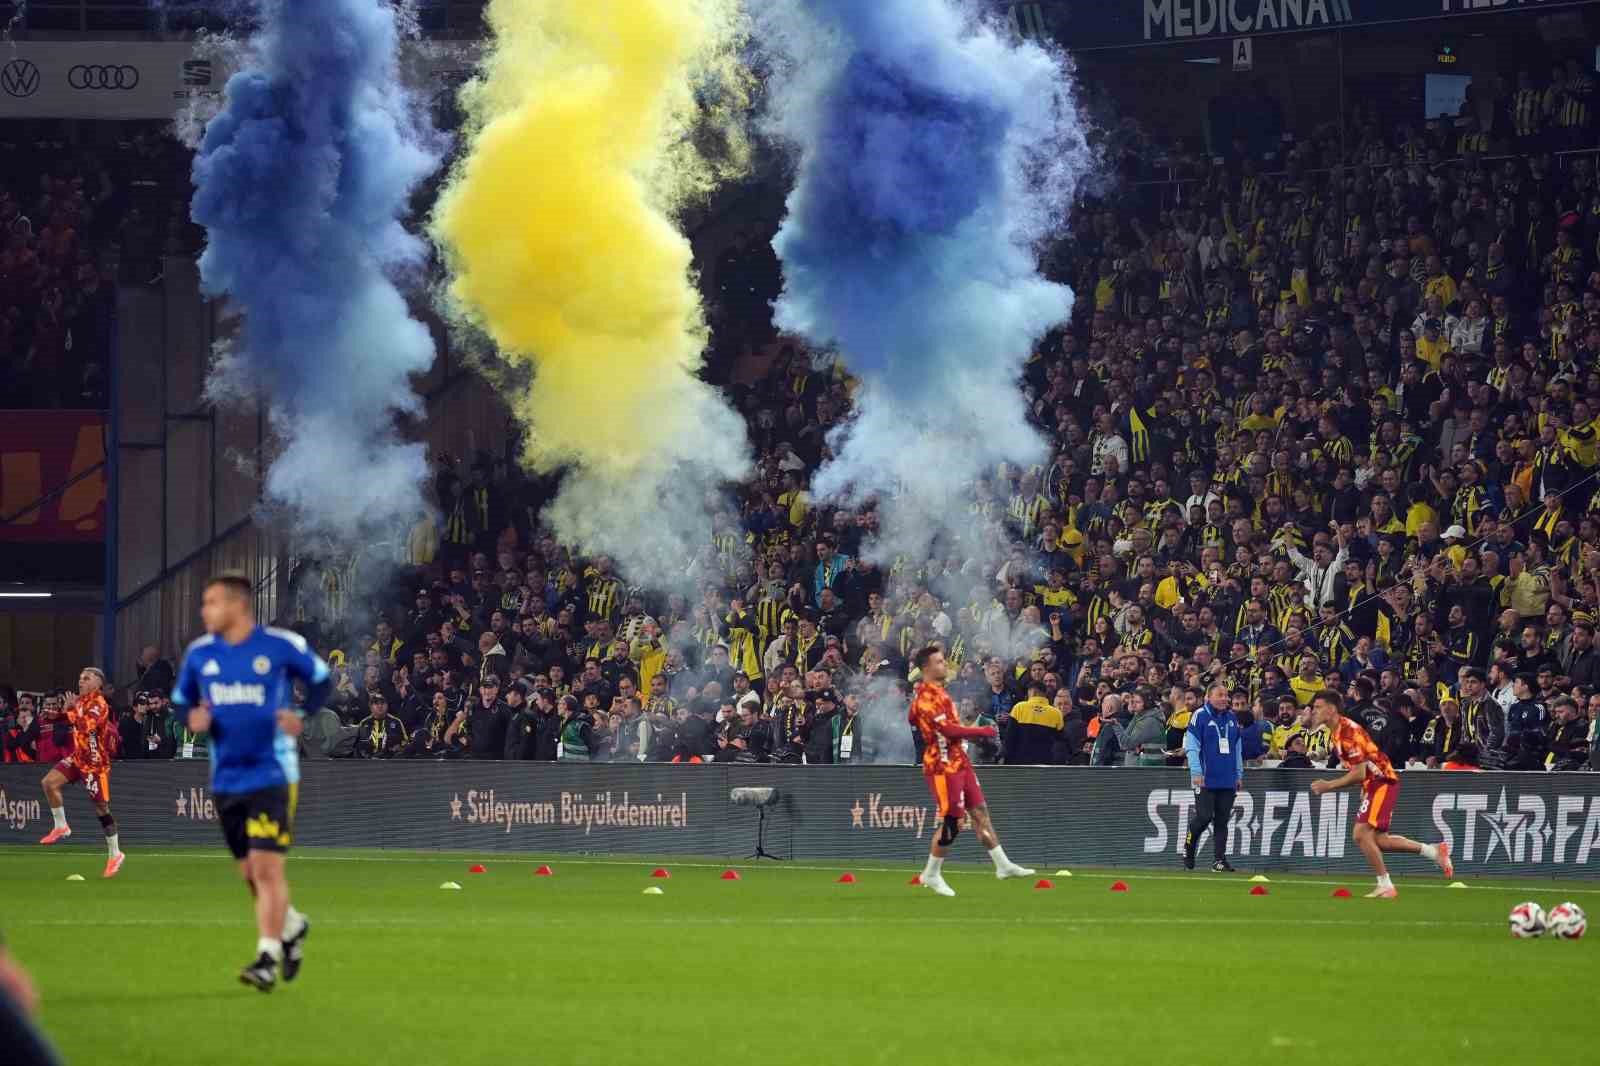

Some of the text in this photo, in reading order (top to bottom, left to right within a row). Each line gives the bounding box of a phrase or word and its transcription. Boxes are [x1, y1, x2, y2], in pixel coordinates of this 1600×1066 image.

[1143, 0, 1329, 40] MEDICANA
[1237, 41, 1247, 61] A
[467, 789, 688, 836] Süleyman Büyükdemirel
[869, 793, 927, 839] Koray
